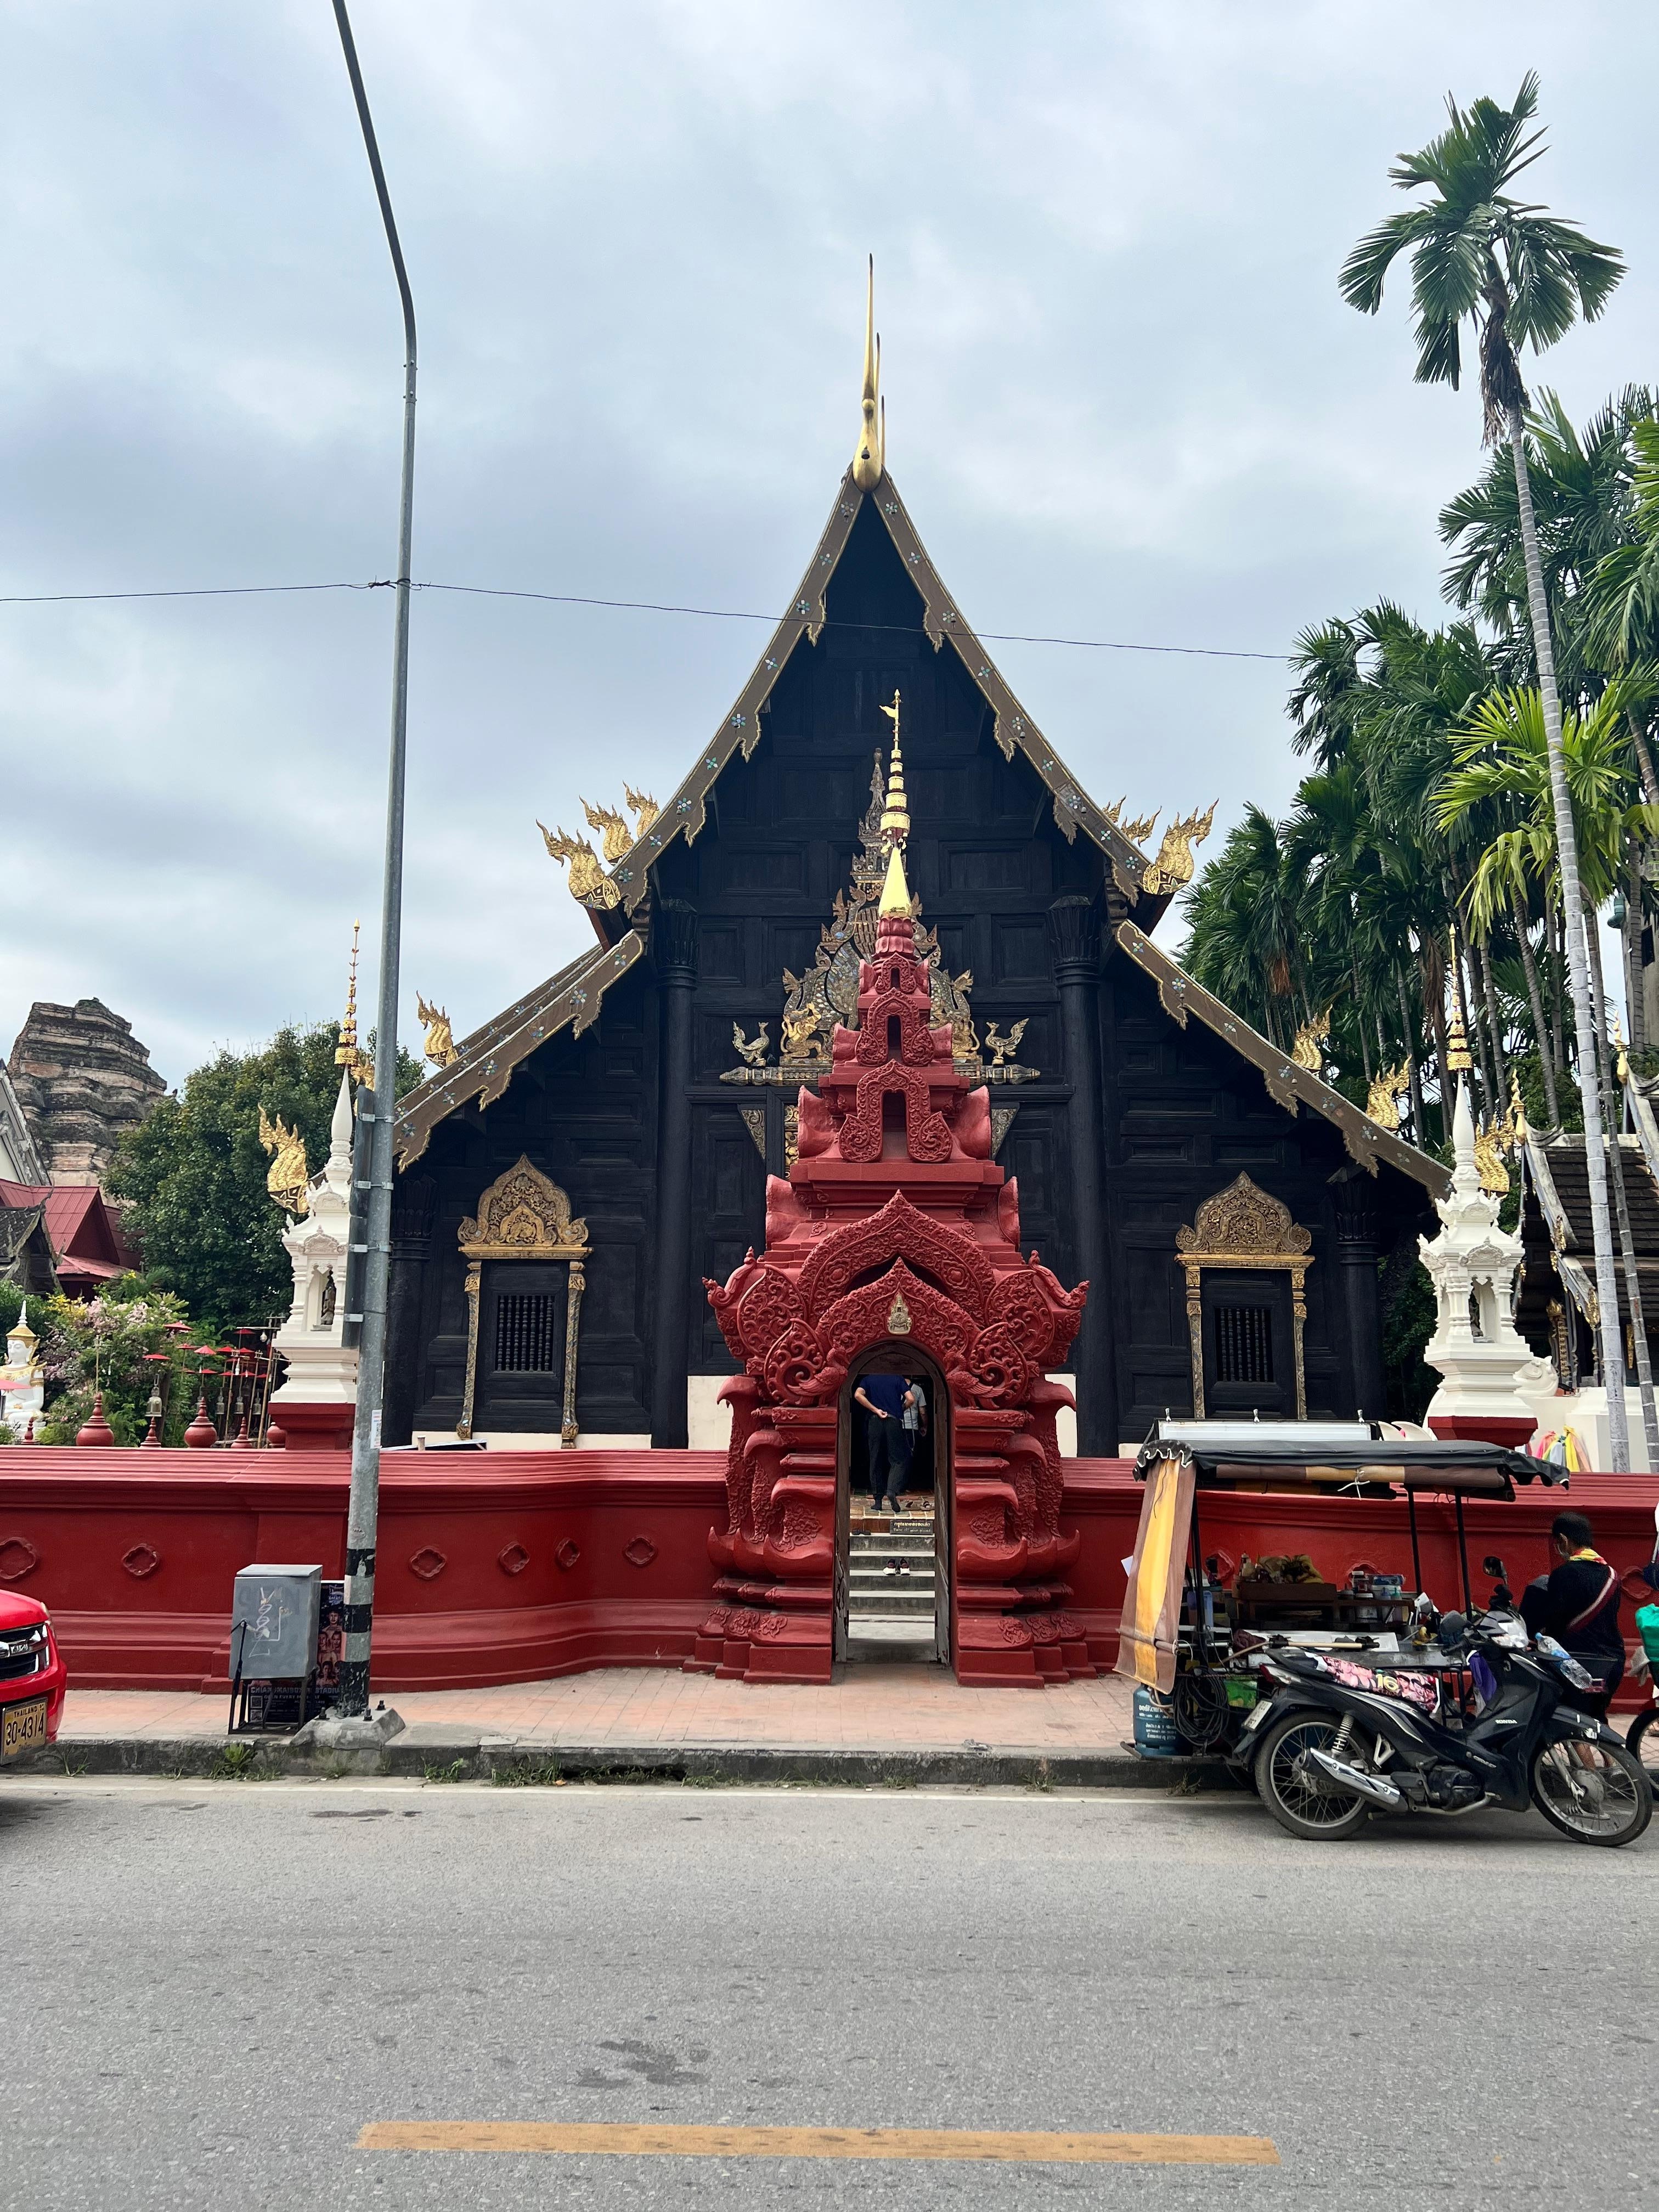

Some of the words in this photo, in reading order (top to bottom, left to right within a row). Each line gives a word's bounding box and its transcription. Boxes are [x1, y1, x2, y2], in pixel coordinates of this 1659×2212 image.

[1376, 1674, 1399, 1691] 16
[14, 1706, 37, 1718] THAILAND
[5, 1713, 44, 1746] 30-4314
